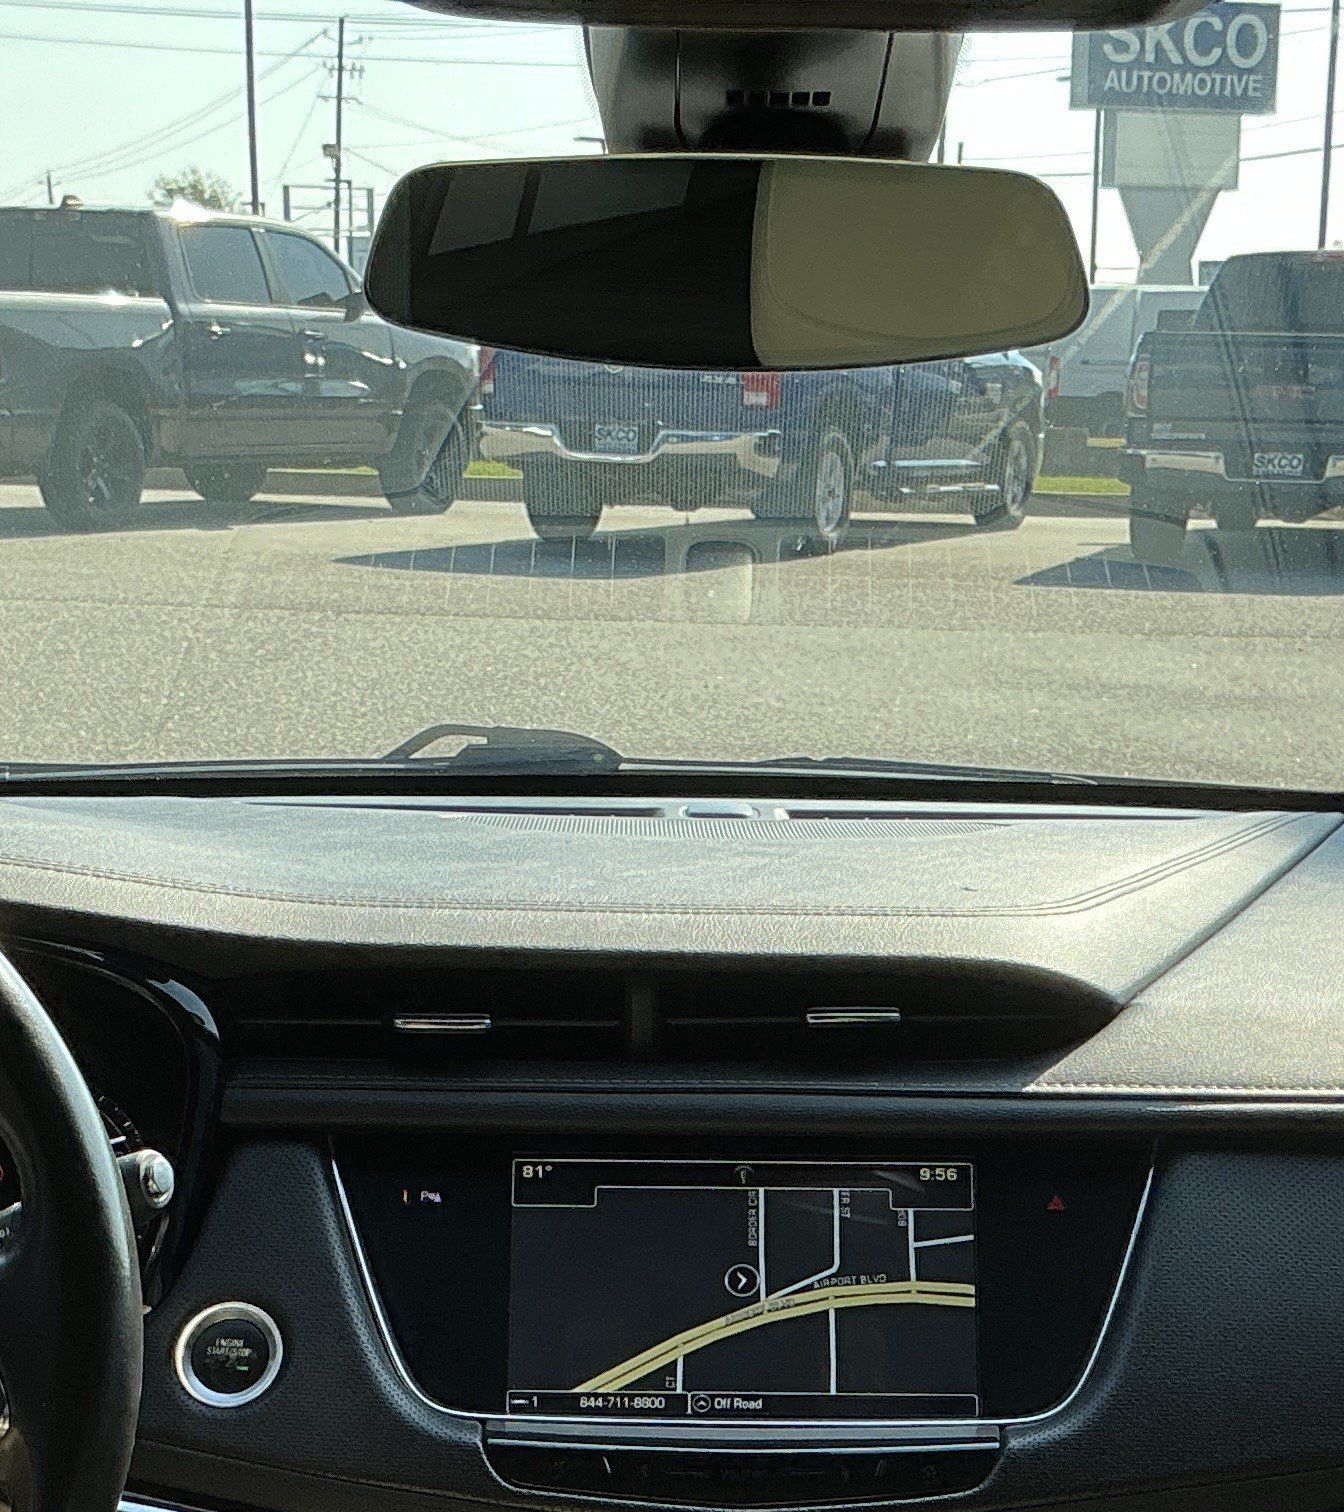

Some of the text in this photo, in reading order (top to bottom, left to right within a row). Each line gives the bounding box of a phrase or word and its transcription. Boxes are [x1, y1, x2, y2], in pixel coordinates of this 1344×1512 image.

[1102, 14, 1268, 69] SKCO
[1103, 69, 1264, 97] AUTOMOTIVE
[1254, 455, 1302, 469] SKCO
[919, 1167, 958, 1181] 9:56
[840, 1206, 851, 1219] ST
[747, 1210, 758, 1247] BORDER
[813, 1274, 858, 1290] AIRPORT
[665, 1376, 676, 1389] CT
[579, 1396, 666, 1409] 844-711-8800
[714, 1397, 763, 1410] Off Road
